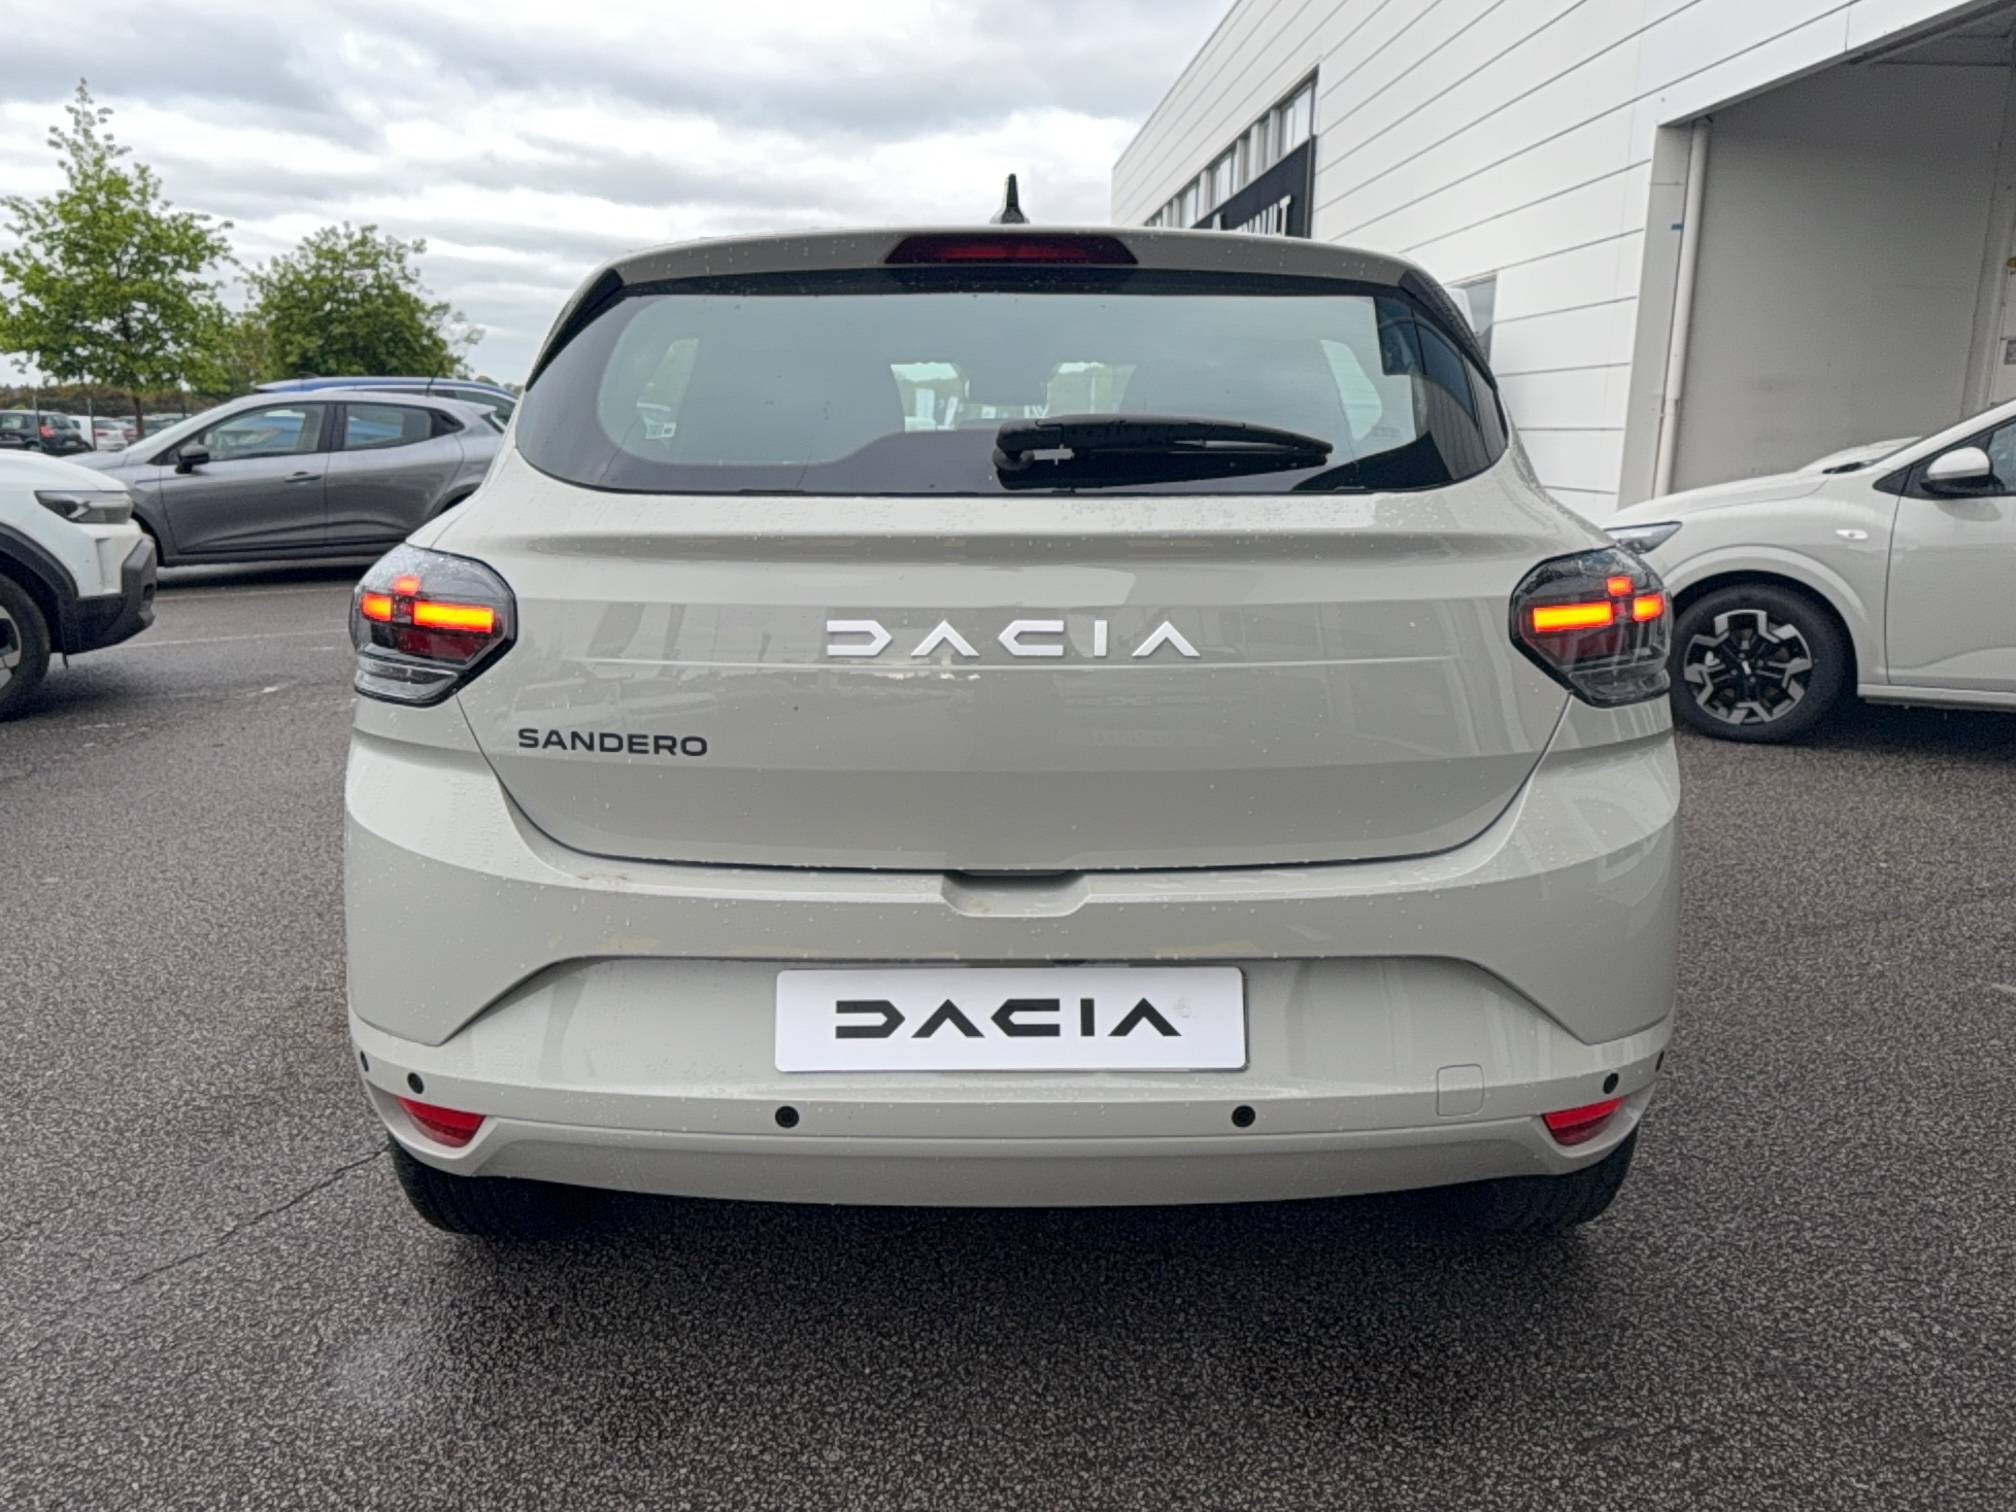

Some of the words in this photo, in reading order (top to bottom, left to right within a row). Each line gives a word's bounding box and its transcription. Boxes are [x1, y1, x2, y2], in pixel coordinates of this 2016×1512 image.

[826, 619, 1200, 657] DACIA
[518, 728, 708, 757] SANDERO
[835, 998, 1182, 1039] DACIA
